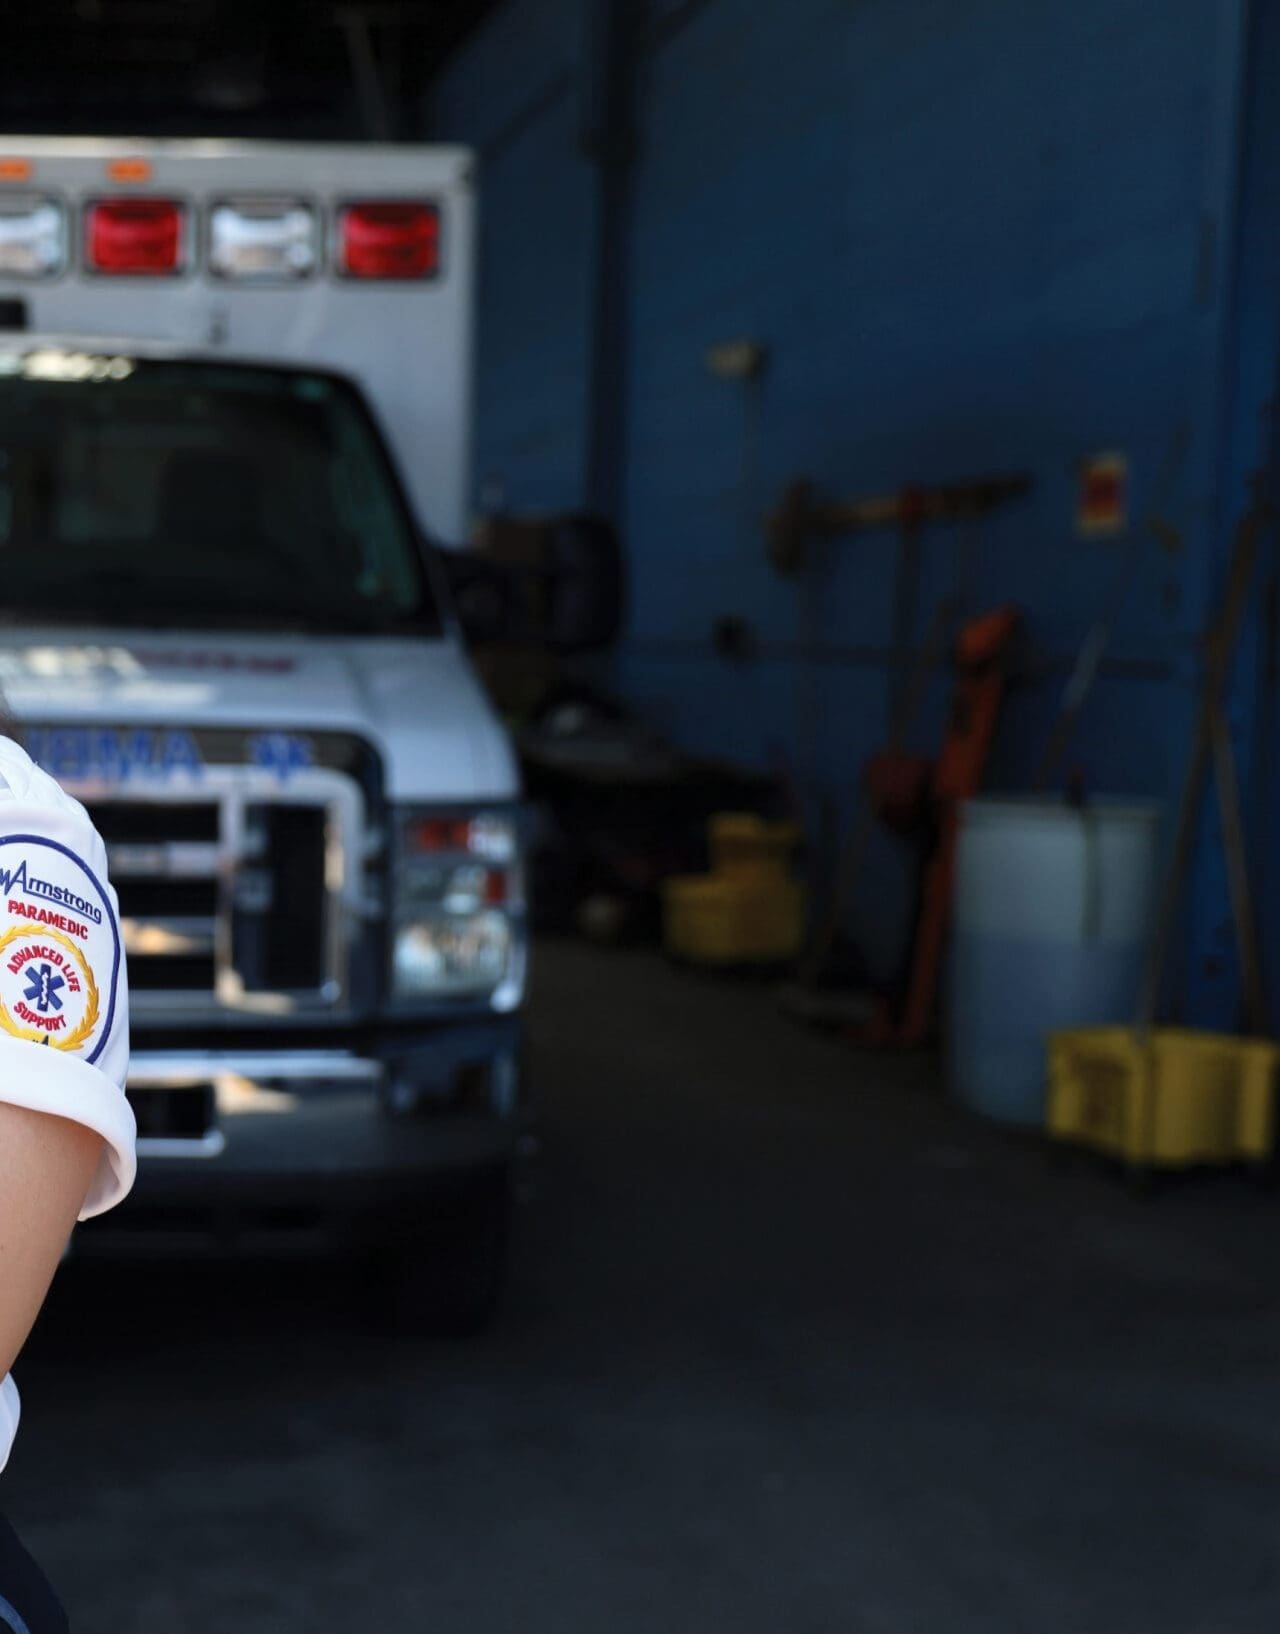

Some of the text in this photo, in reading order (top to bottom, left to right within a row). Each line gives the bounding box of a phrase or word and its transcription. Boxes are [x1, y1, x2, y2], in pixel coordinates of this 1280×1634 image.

[4, 859, 103, 925] Armstrong
[7, 899, 89, 940] PARAMEDIC
[6, 944, 81, 993] ADVANCED LIFE
[13, 1000, 67, 1031] SUPPORT
